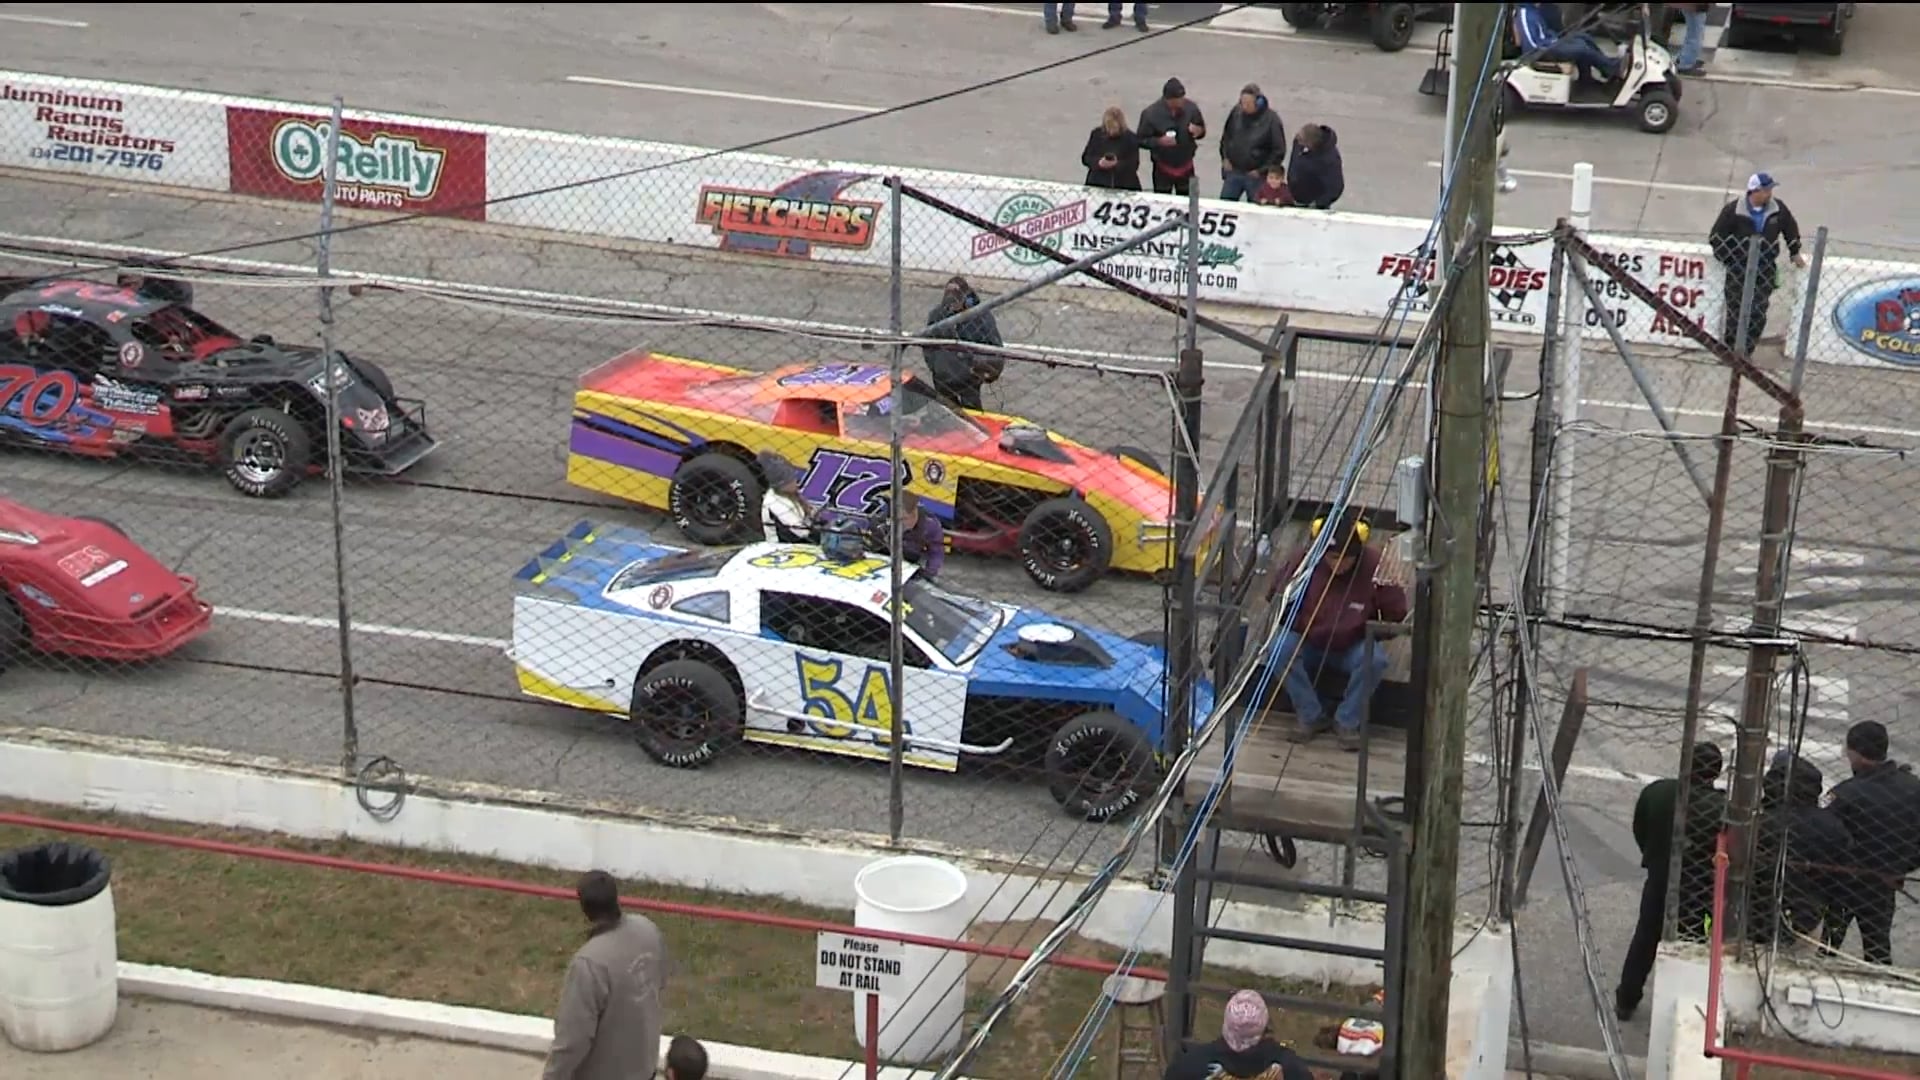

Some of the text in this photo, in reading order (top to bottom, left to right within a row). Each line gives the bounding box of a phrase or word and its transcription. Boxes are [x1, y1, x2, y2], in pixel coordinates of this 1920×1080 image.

[0, 85, 123, 112] luminum
[48, 126, 175, 152] Radiators
[277, 124, 440, 194] O'Reilly
[326, 186, 403, 207] UTO PARTS
[704, 192, 873, 243] FLETCHERS
[977, 207, 1079, 253] COMU-GRAPHIX
[1094, 201, 1238, 237] 433-255
[1099, 262, 1237, 289] compu-graph.com
[1489, 268, 1547, 290] DIES
[799, 449, 909, 514] 17
[796, 651, 911, 750] 54
[843, 938, 879, 953] Please
[821, 950, 901, 976] DO NOT STAND
[840, 971, 880, 991] AT RAIL
